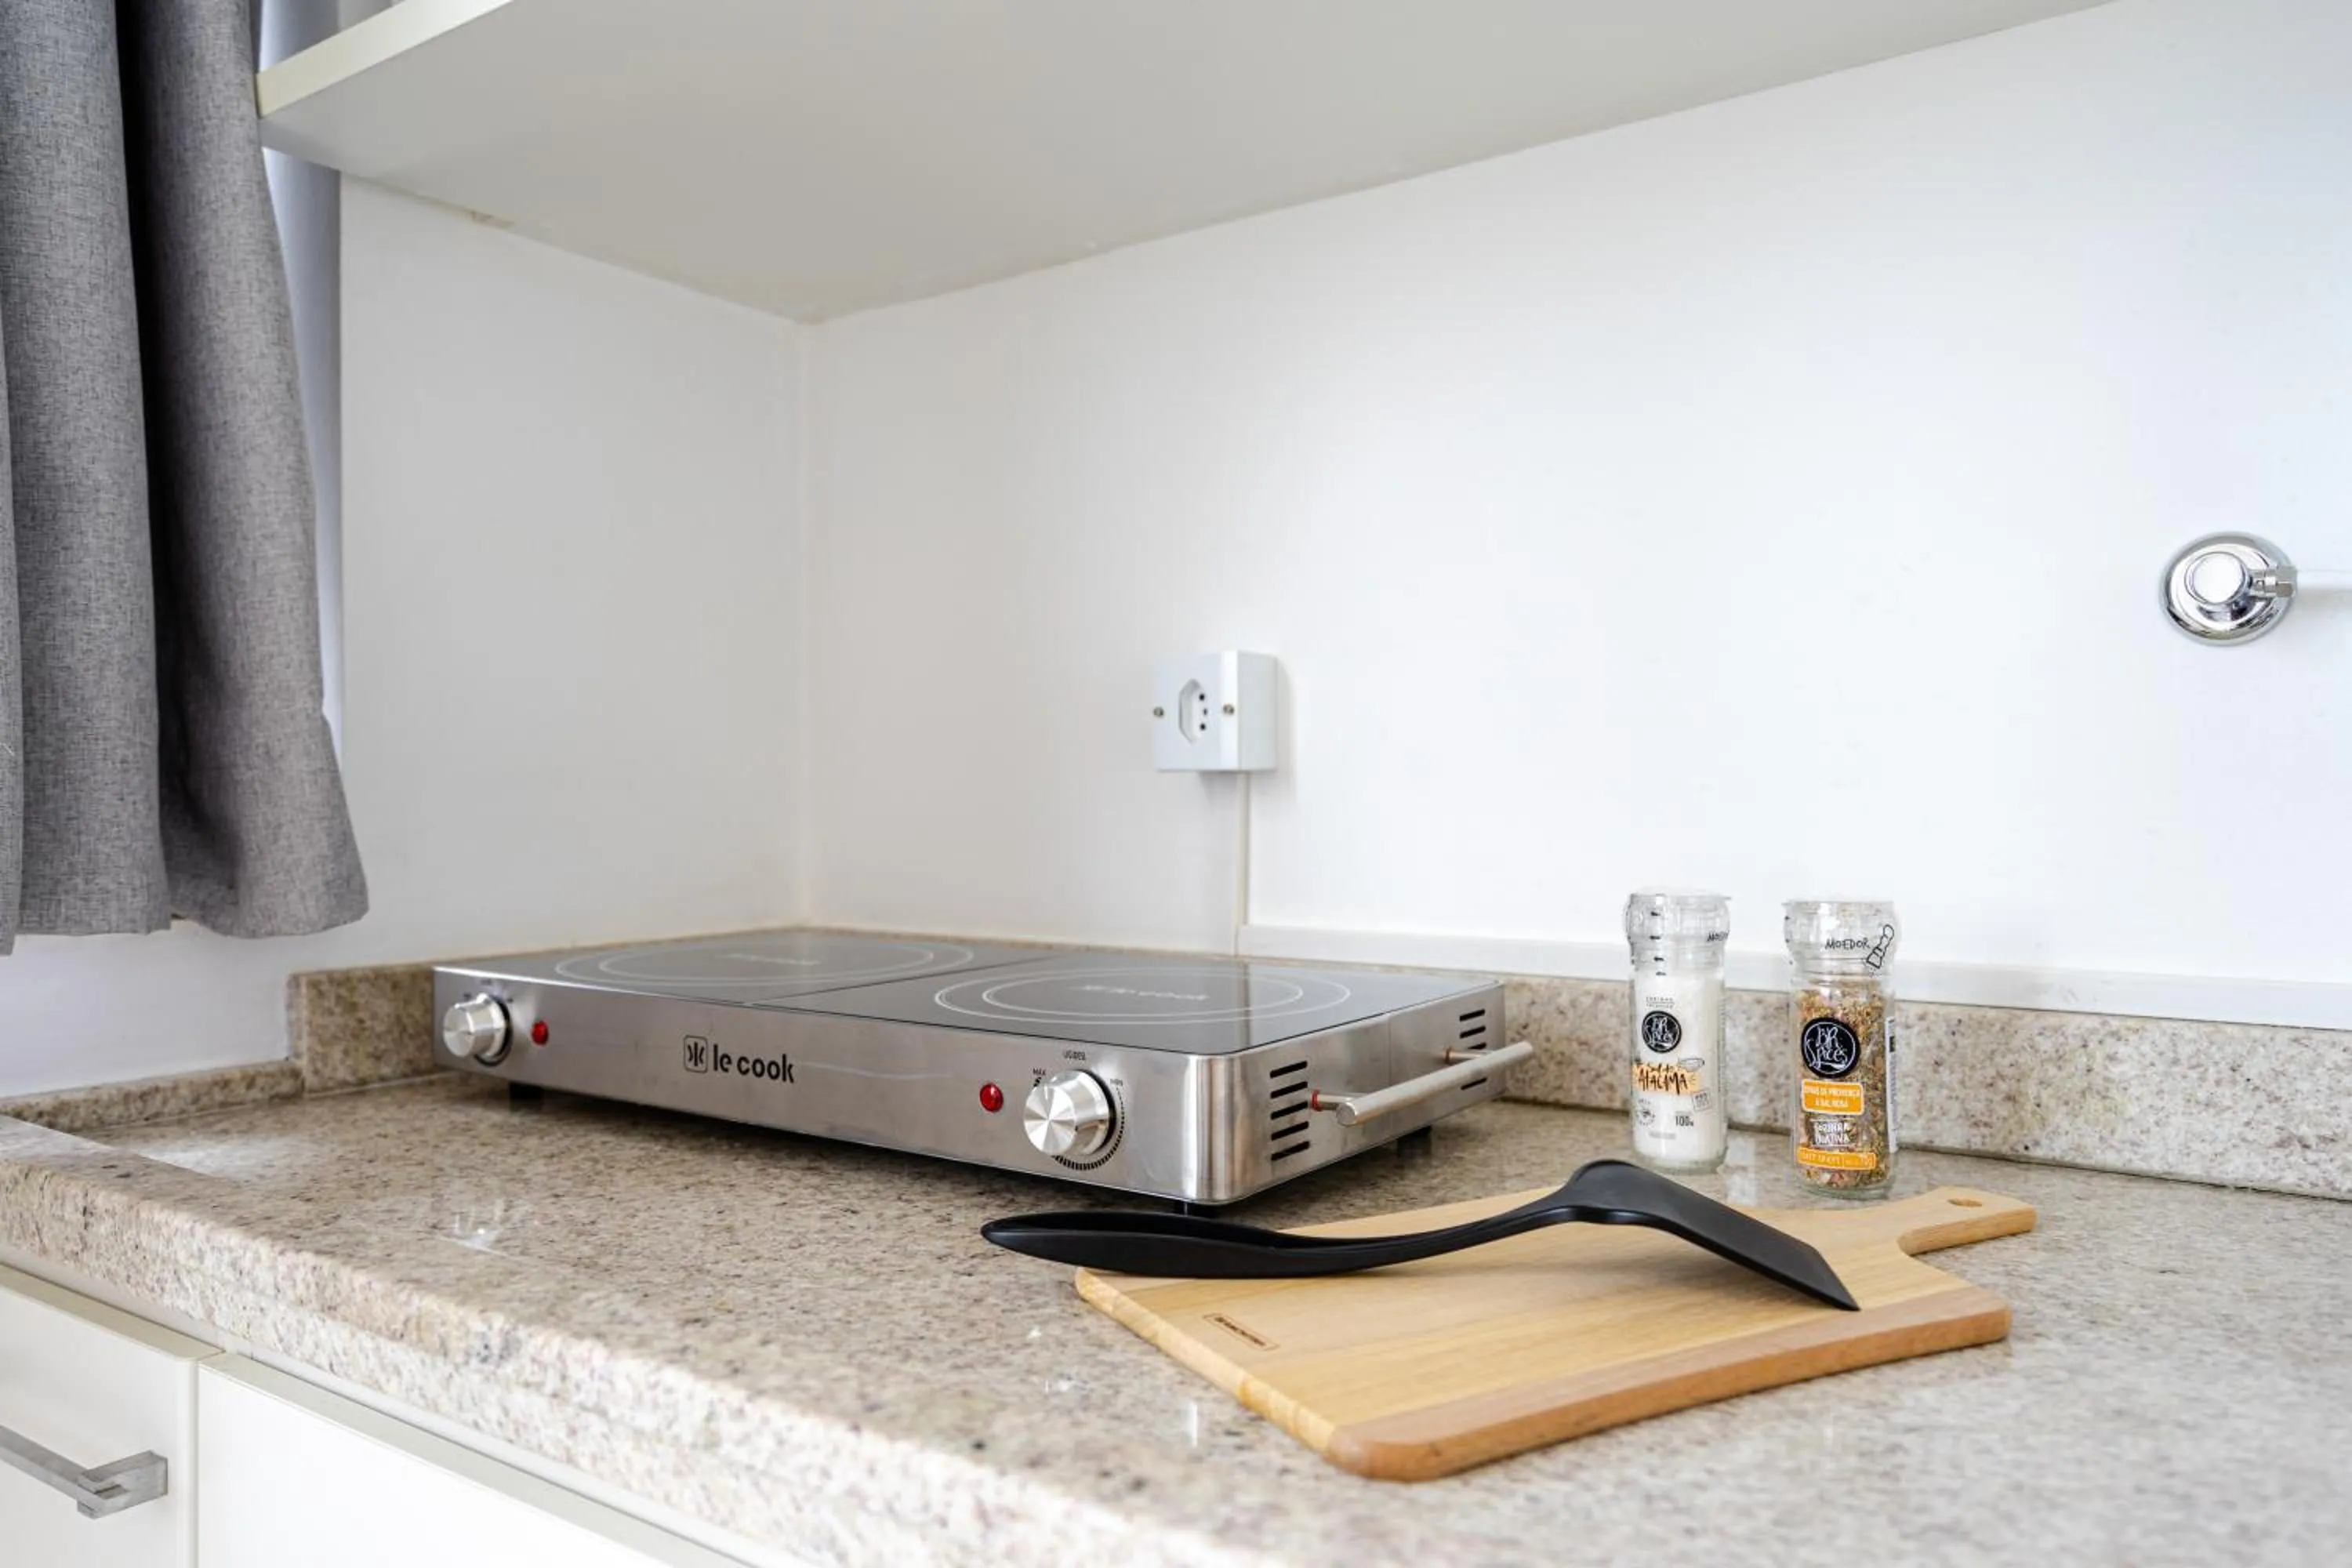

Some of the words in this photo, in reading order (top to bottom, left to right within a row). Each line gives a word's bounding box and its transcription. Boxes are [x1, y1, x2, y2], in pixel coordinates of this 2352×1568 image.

[1825, 938, 1870, 950] MOEDOR
[713, 1044, 732, 1073] le
[737, 1053, 793, 1083] cook
